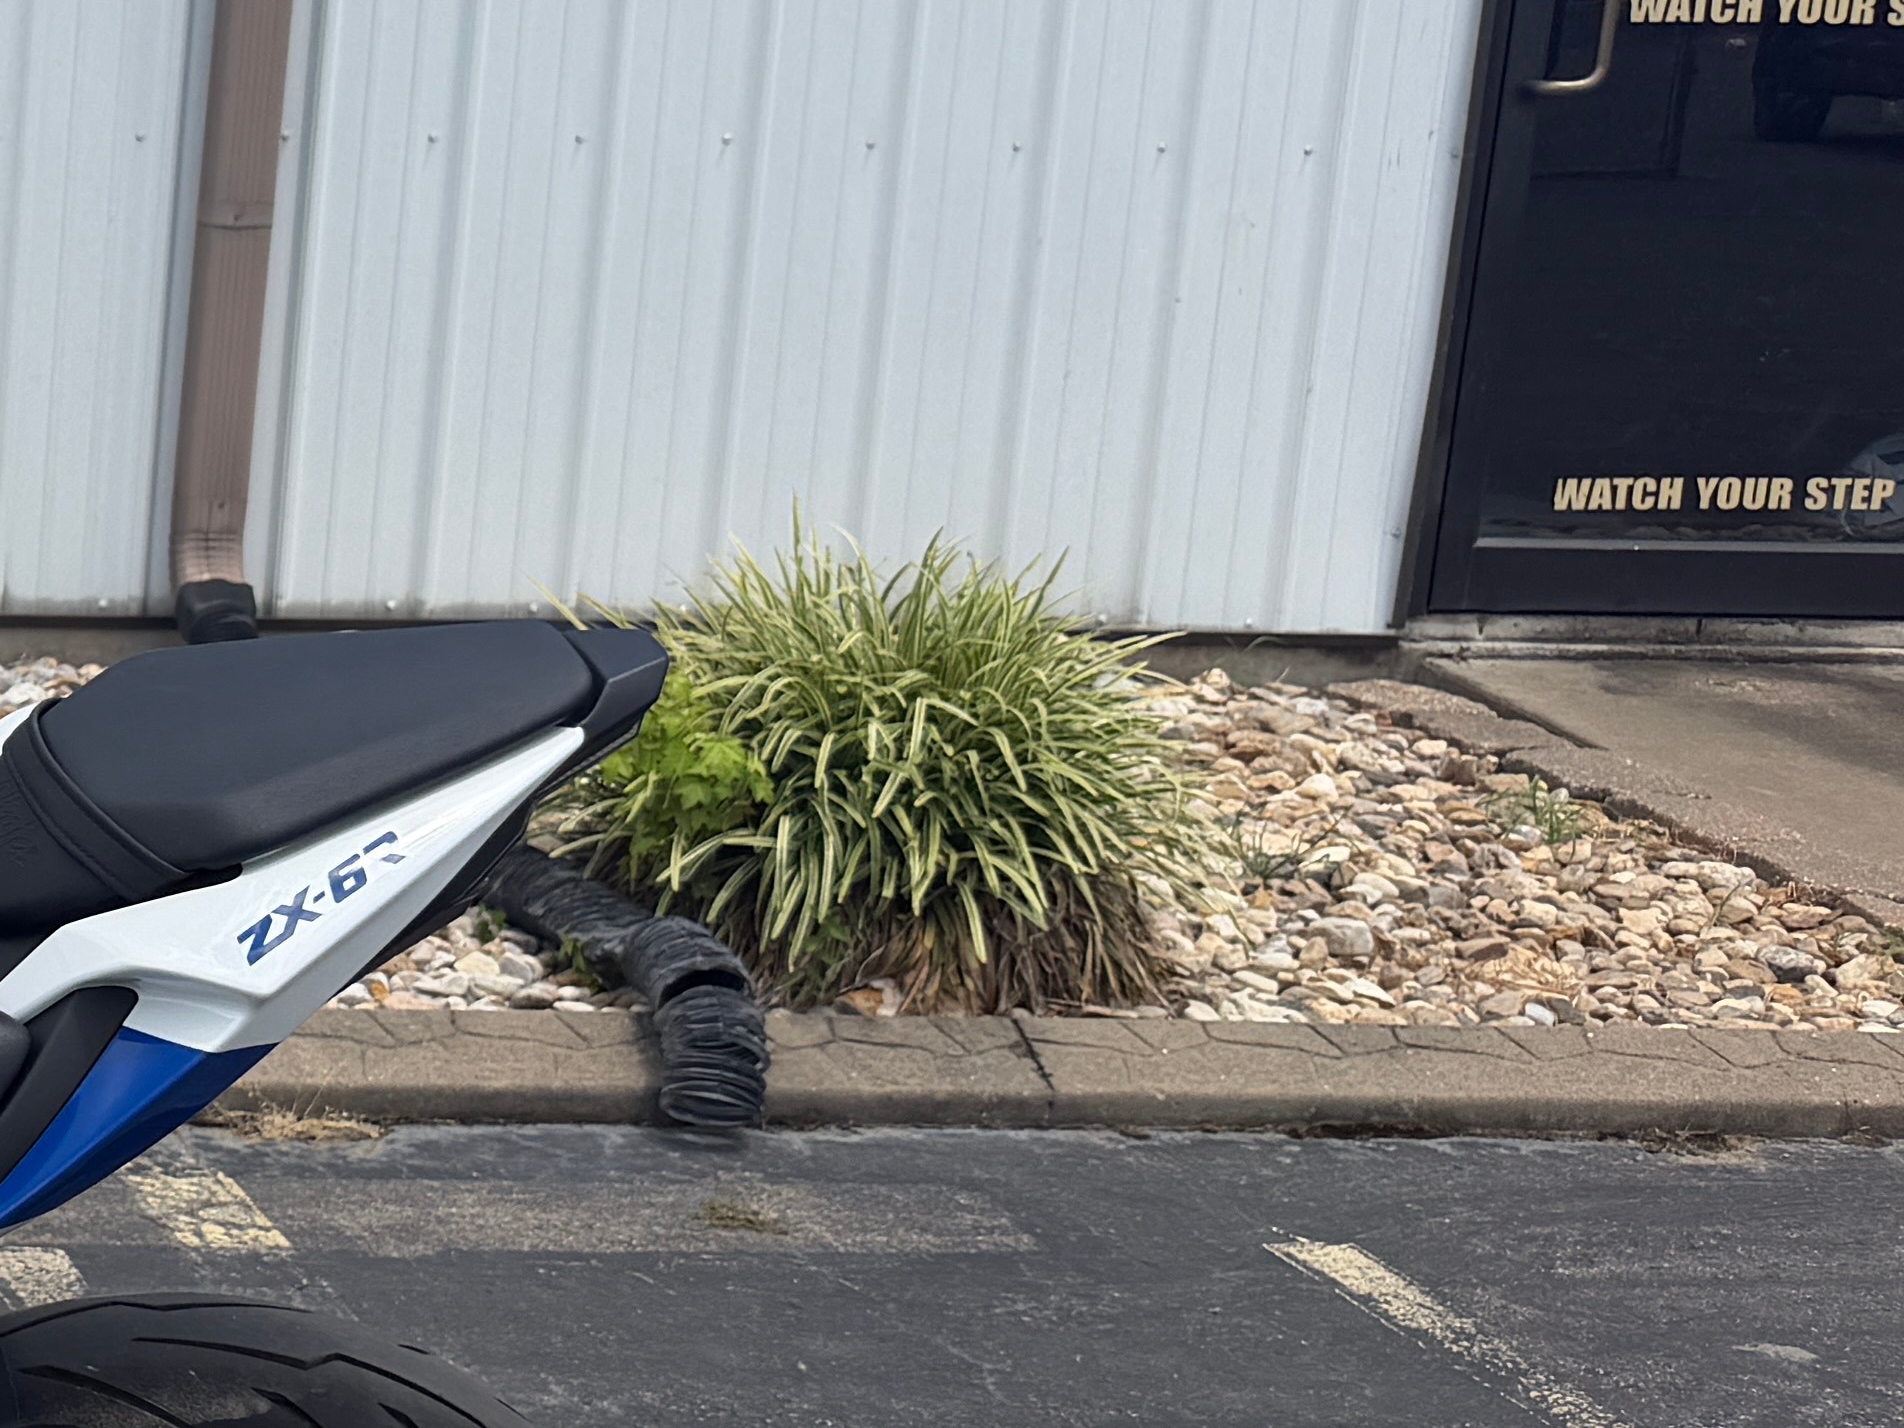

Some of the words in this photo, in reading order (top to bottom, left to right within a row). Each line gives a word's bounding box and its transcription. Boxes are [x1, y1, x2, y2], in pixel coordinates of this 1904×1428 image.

[1554, 477, 1683, 511] WATCH
[1696, 477, 1795, 511] YOUR
[1804, 477, 1896, 511] STEP
